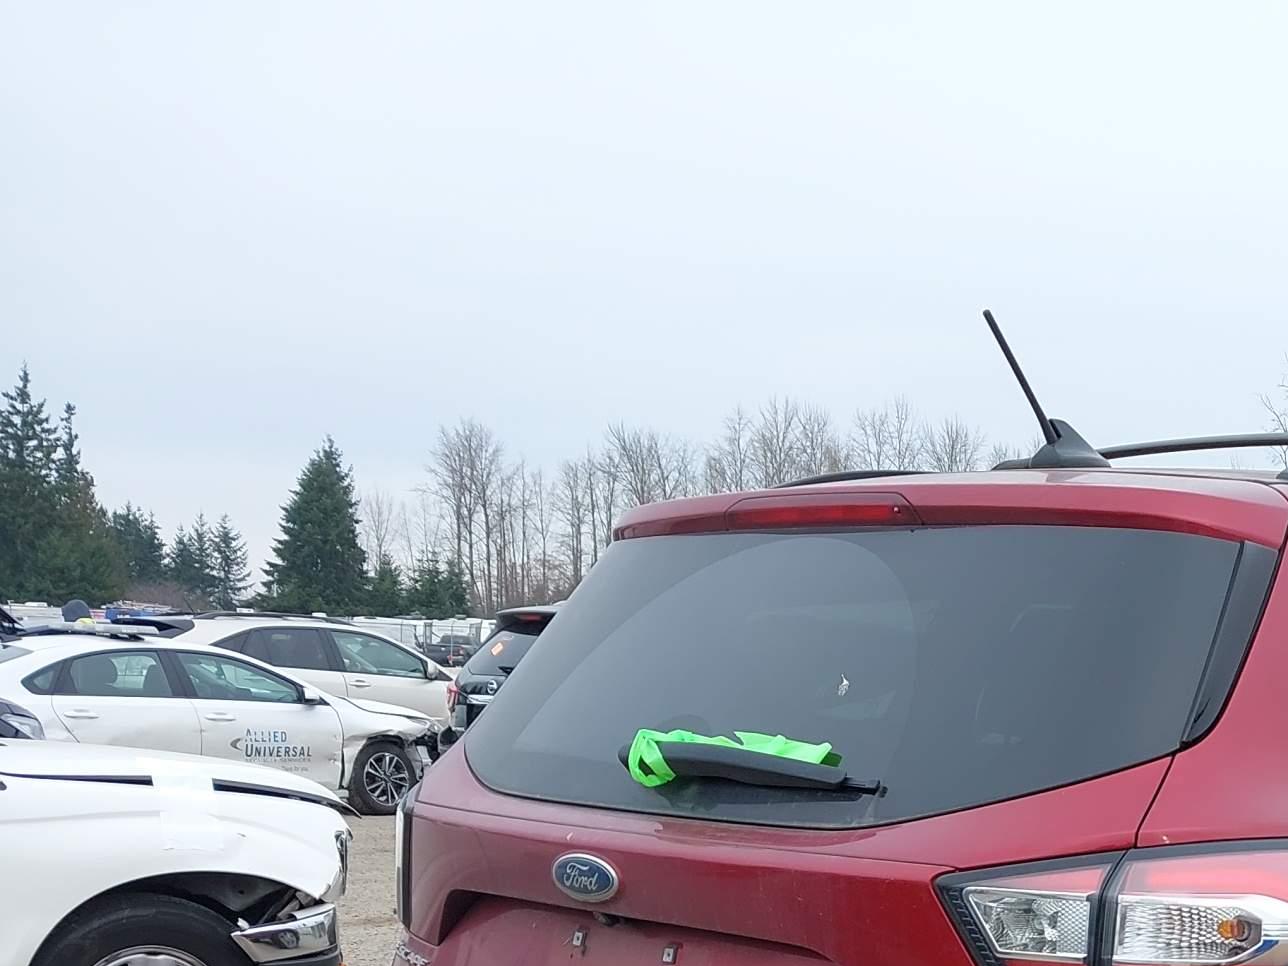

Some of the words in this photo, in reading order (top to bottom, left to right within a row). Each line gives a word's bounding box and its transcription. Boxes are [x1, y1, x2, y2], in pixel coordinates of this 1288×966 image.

[244, 728, 287, 743] ALLIED
[244, 743, 312, 758] UNIVERSAL
[564, 863, 599, 890] Ford
